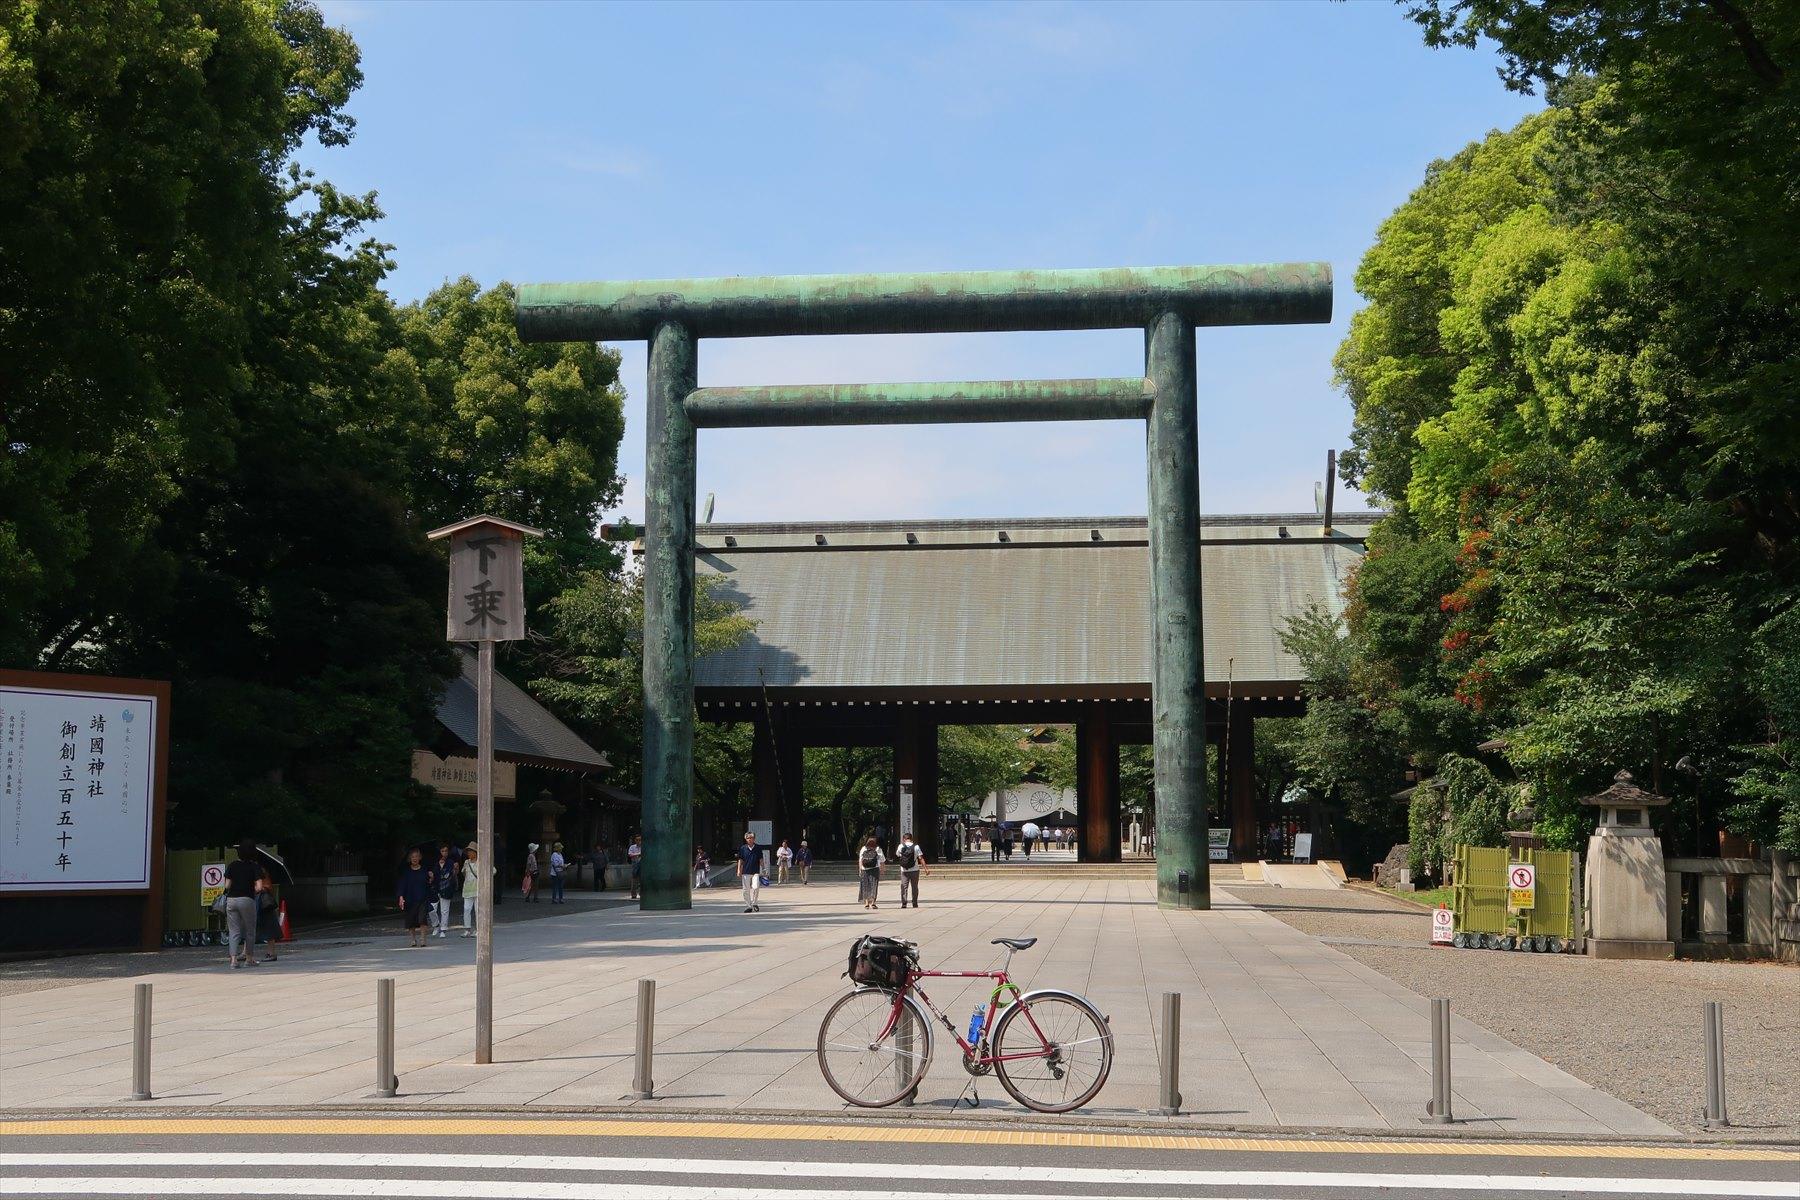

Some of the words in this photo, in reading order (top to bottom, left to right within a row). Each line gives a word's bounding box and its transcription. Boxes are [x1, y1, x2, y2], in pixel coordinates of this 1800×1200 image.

[464, 536, 508, 629] 下乗
[54, 720, 78, 872] 御創立百五十年
[86, 713, 107, 798] 靖國神社
